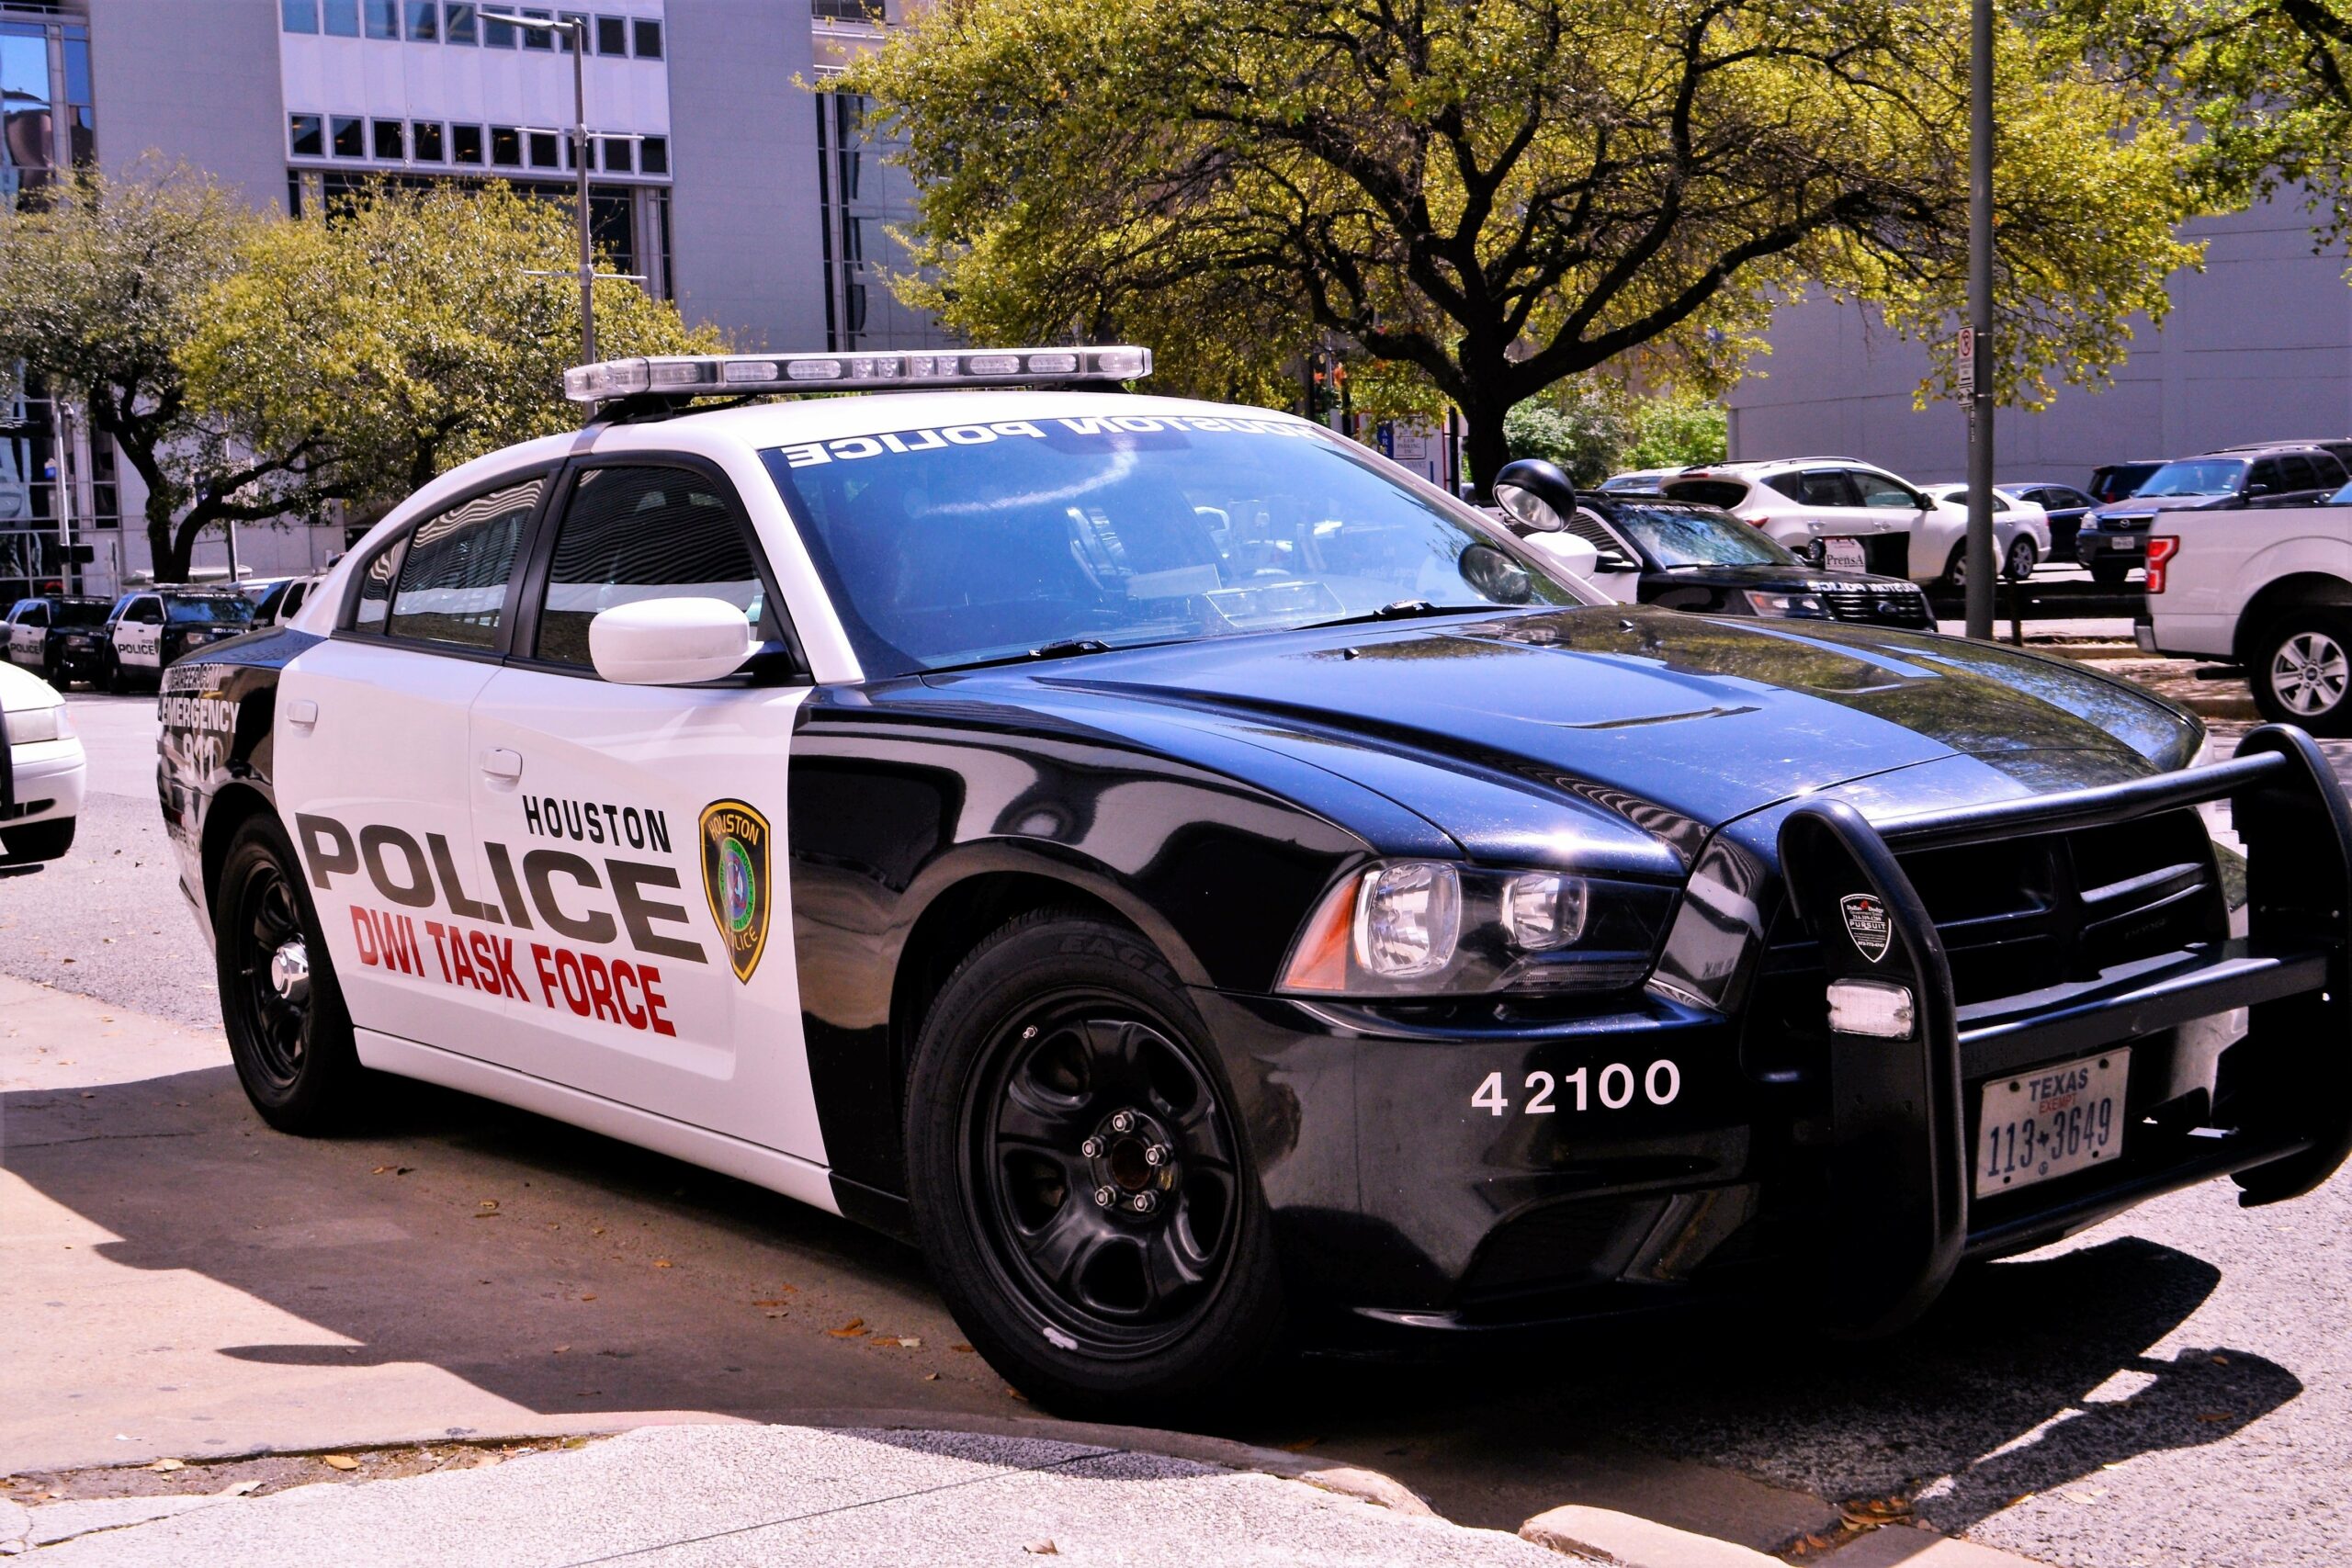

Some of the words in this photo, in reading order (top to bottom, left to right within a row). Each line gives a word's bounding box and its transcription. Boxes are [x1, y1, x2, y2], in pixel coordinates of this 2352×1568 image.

[10, 643, 40, 655] POLICE
[118, 643, 156, 655] POLICE
[162, 697, 240, 734] EMERGENCY
[183, 734, 216, 784] 911
[522, 795, 672, 853] HOUSTON
[708, 814, 759, 846] HOUSTON
[295, 812, 708, 964] POLICE
[1849, 920, 1886, 930] PURSUIT
[349, 905, 425, 977] DWI
[424, 919, 530, 1003] TASK
[530, 943, 677, 1038] FORCE
[1058, 935, 1188, 1001] EAGL
[1471, 1059, 1680, 1116] 42100
[2029, 1067, 2088, 1101] TEXAS
[2039, 1093, 2077, 1114] EXEMPT
